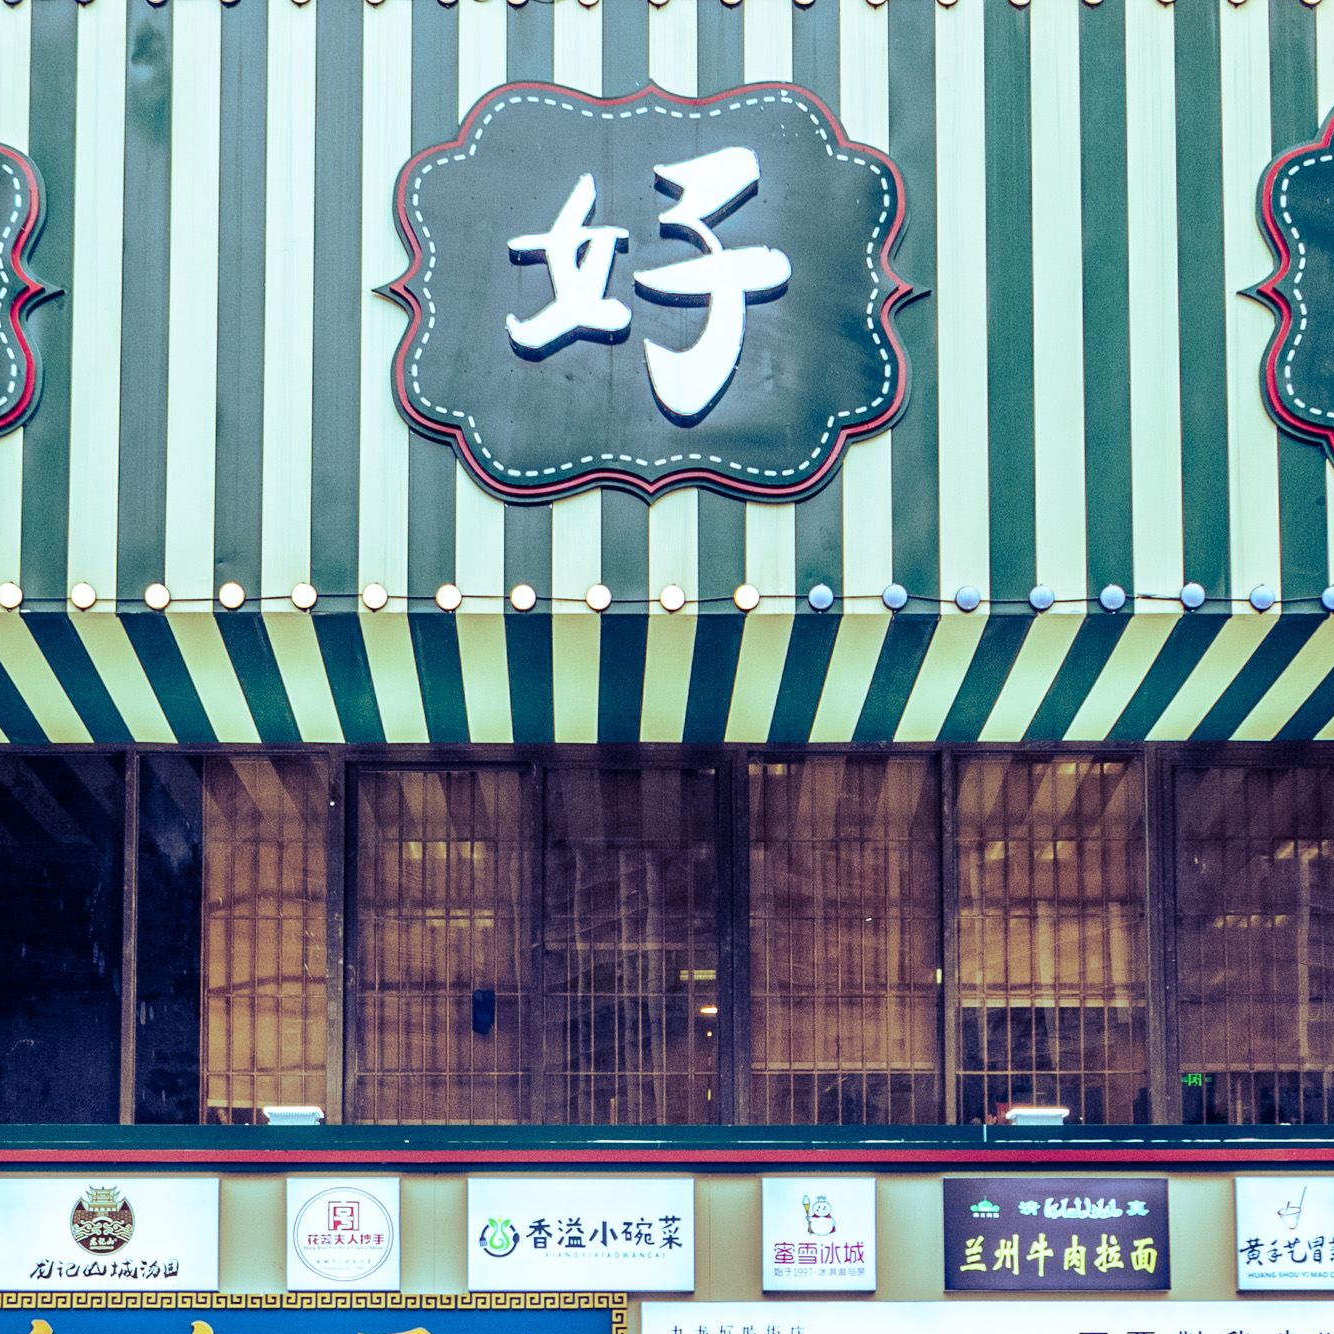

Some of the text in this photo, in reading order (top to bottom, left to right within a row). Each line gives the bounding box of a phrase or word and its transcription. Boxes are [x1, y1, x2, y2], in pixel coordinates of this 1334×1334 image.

[526, 1215, 683, 1250] 香溢小碗菜
[773, 1241, 866, 1265] 蜜雪冰城
[959, 1232, 1158, 1277] 兰州牛肉拉面
